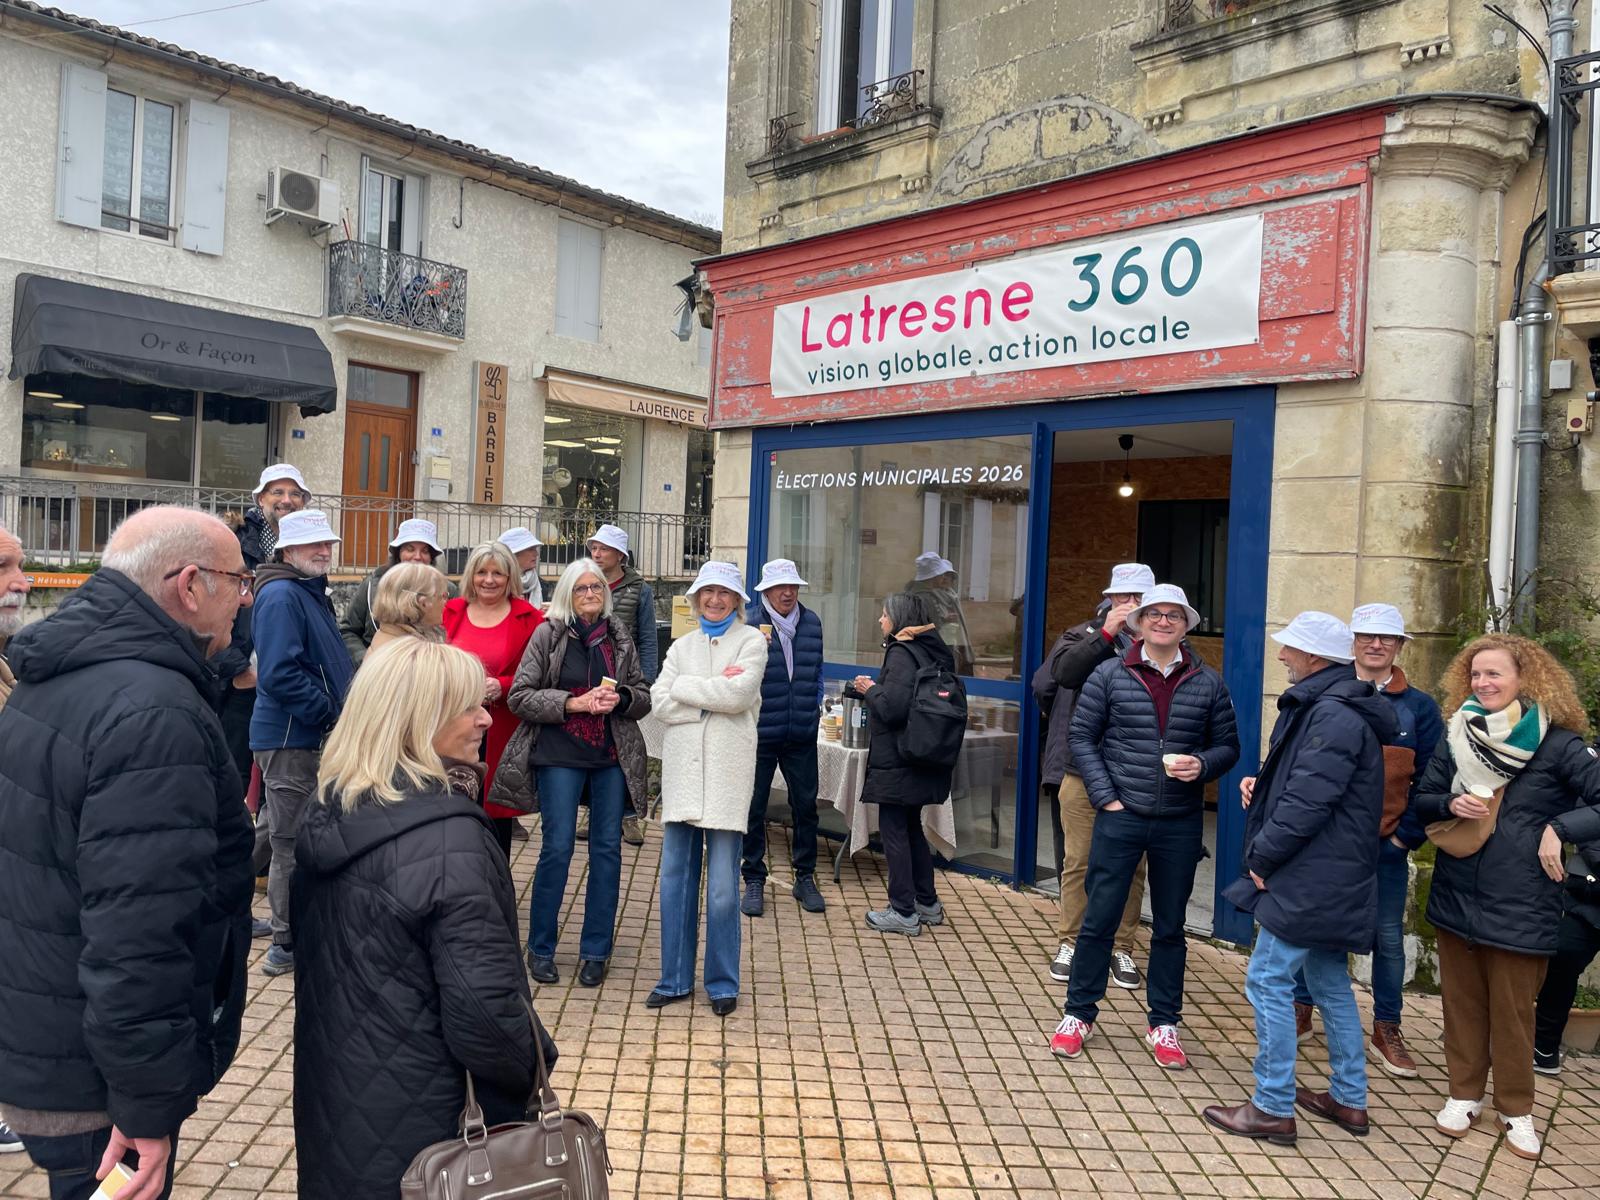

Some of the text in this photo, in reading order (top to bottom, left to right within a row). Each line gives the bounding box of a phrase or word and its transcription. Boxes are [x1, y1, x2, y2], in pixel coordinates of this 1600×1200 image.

[801, 237, 1203, 353] Latresne 360
[141, 332, 257, 365] Or & Façon
[808, 360, 869, 385] vision
[1092, 315, 1190, 350] locale
[629, 399, 695, 422] LAURENCE
[484, 411, 497, 502] BARBIER
[775, 464, 1024, 489] ÉLECTIONS MUNICIPALES 2026
